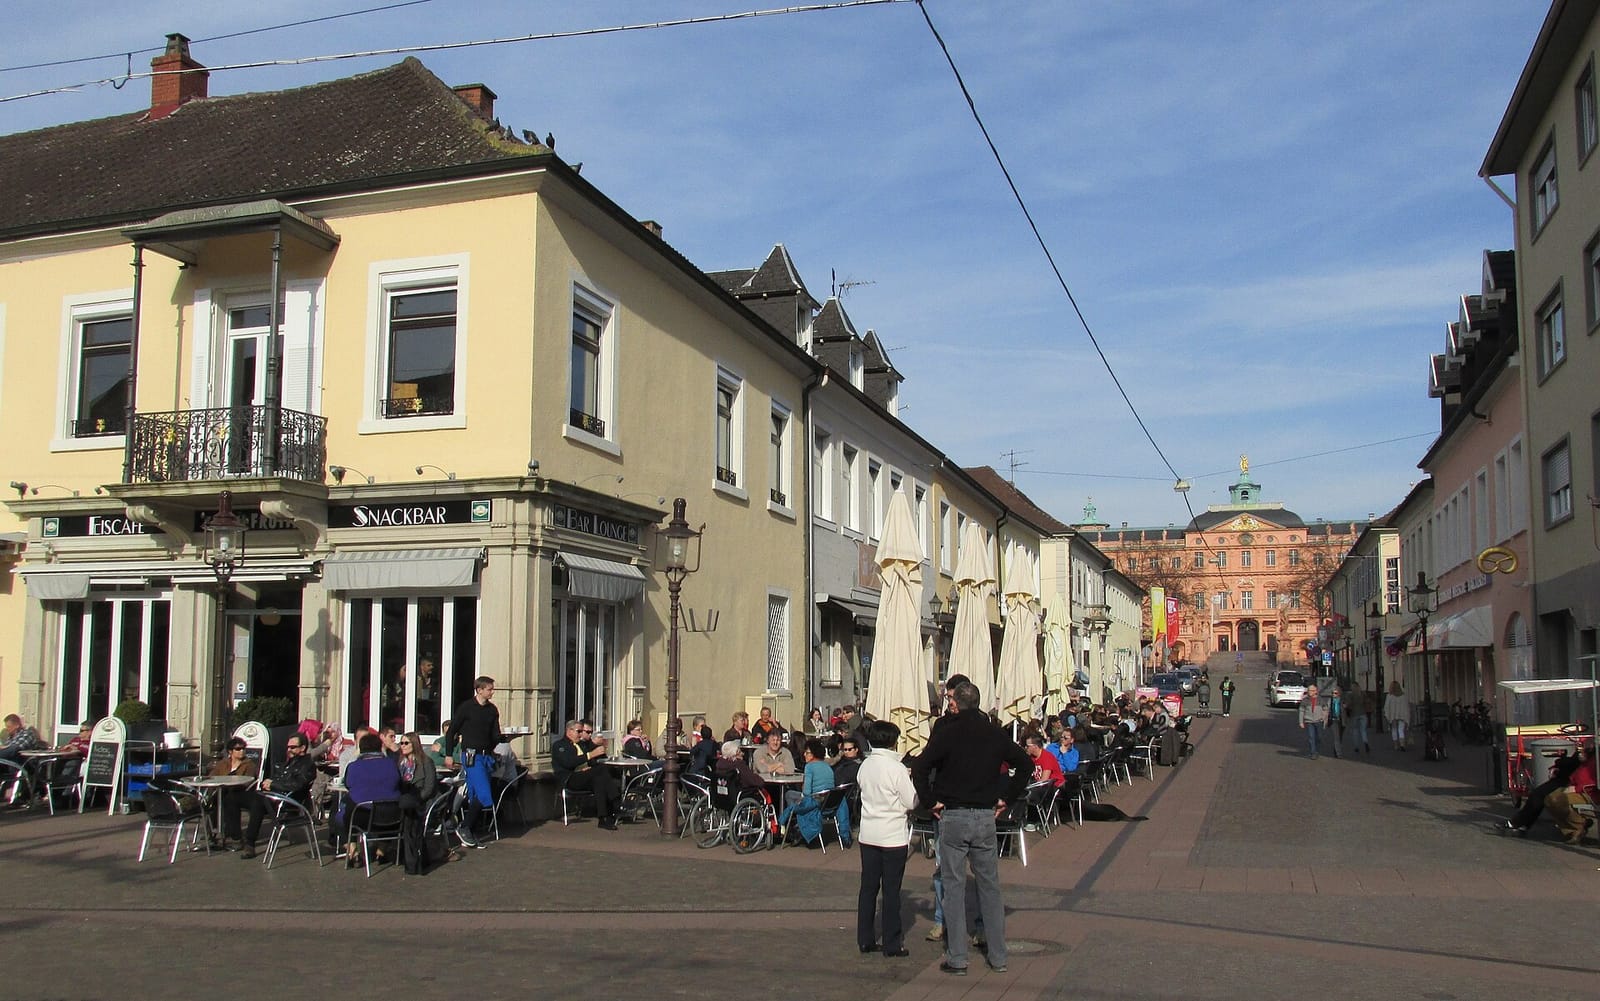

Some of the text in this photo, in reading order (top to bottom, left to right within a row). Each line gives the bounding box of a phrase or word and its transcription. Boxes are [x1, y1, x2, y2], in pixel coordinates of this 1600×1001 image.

[352, 506, 447, 527] SNACKBAR
[566, 508, 627, 541] BAR LOUNGE
[1386, 558, 1398, 614] MUSIK
